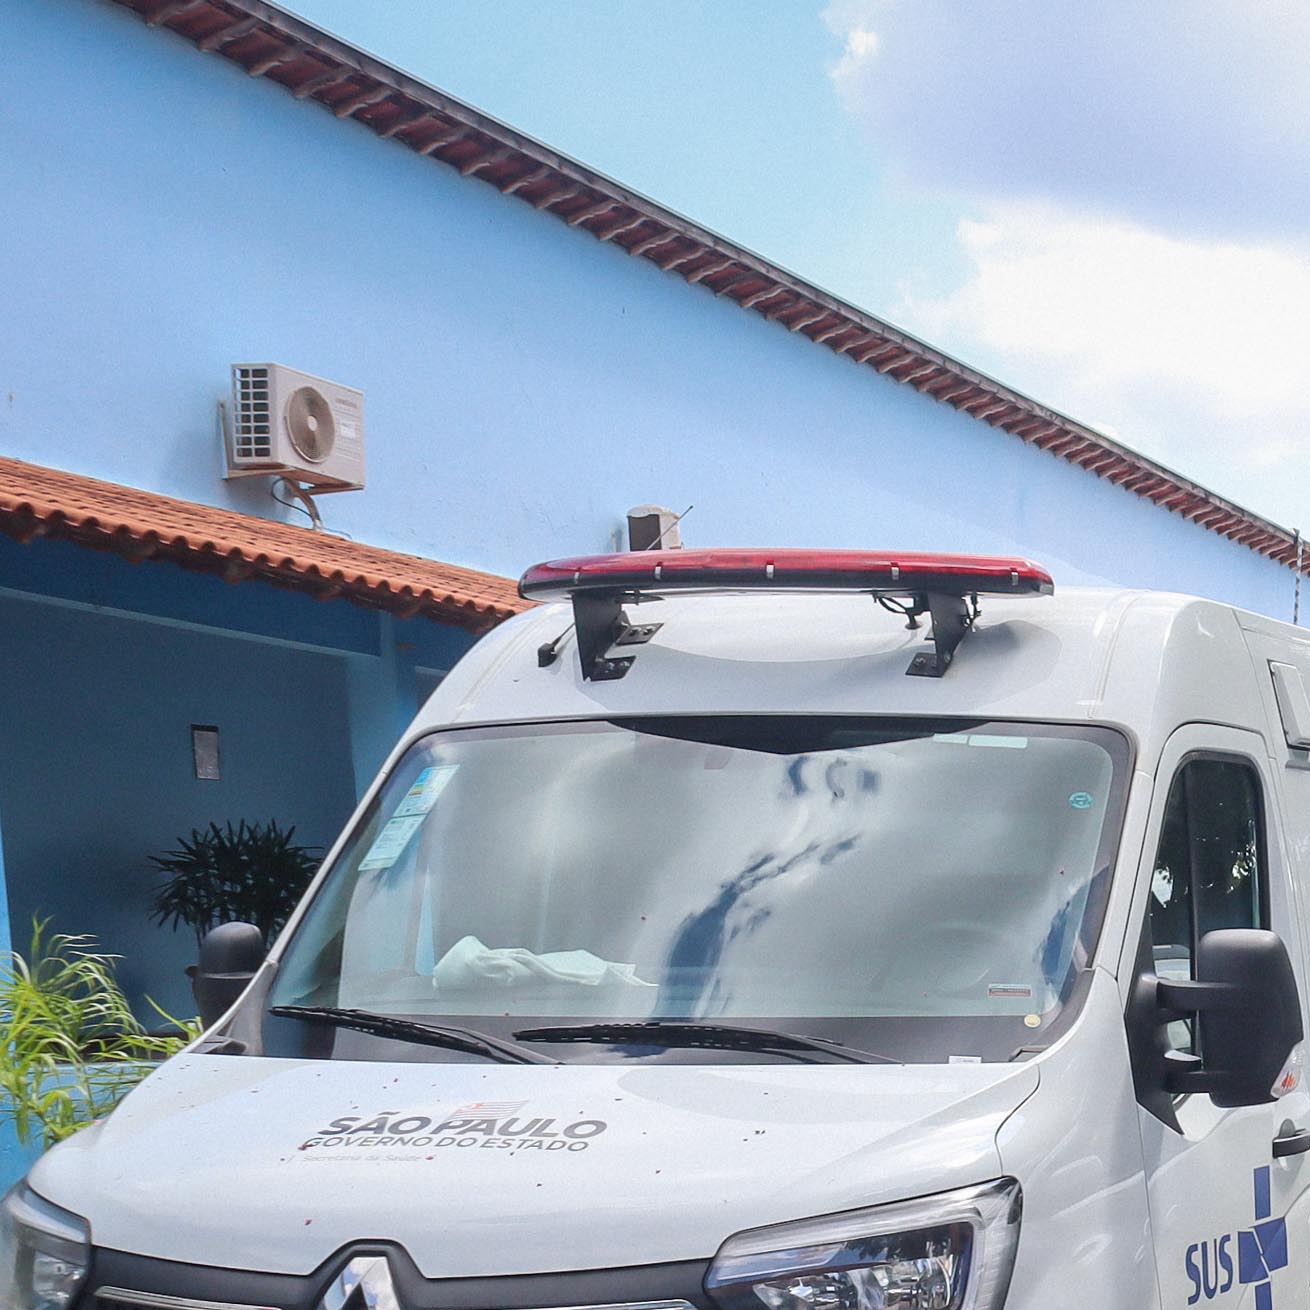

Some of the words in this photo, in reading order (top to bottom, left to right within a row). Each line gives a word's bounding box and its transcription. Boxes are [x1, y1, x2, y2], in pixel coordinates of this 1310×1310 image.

[317, 1111, 433, 1136] SÃO
[429, 1117, 608, 1140] PAULO
[304, 1135, 434, 1149] GOVERNO
[434, 1136, 478, 1149] DO
[479, 1137, 590, 1152] ESTADO
[1184, 1233, 1234, 1306] SUS
